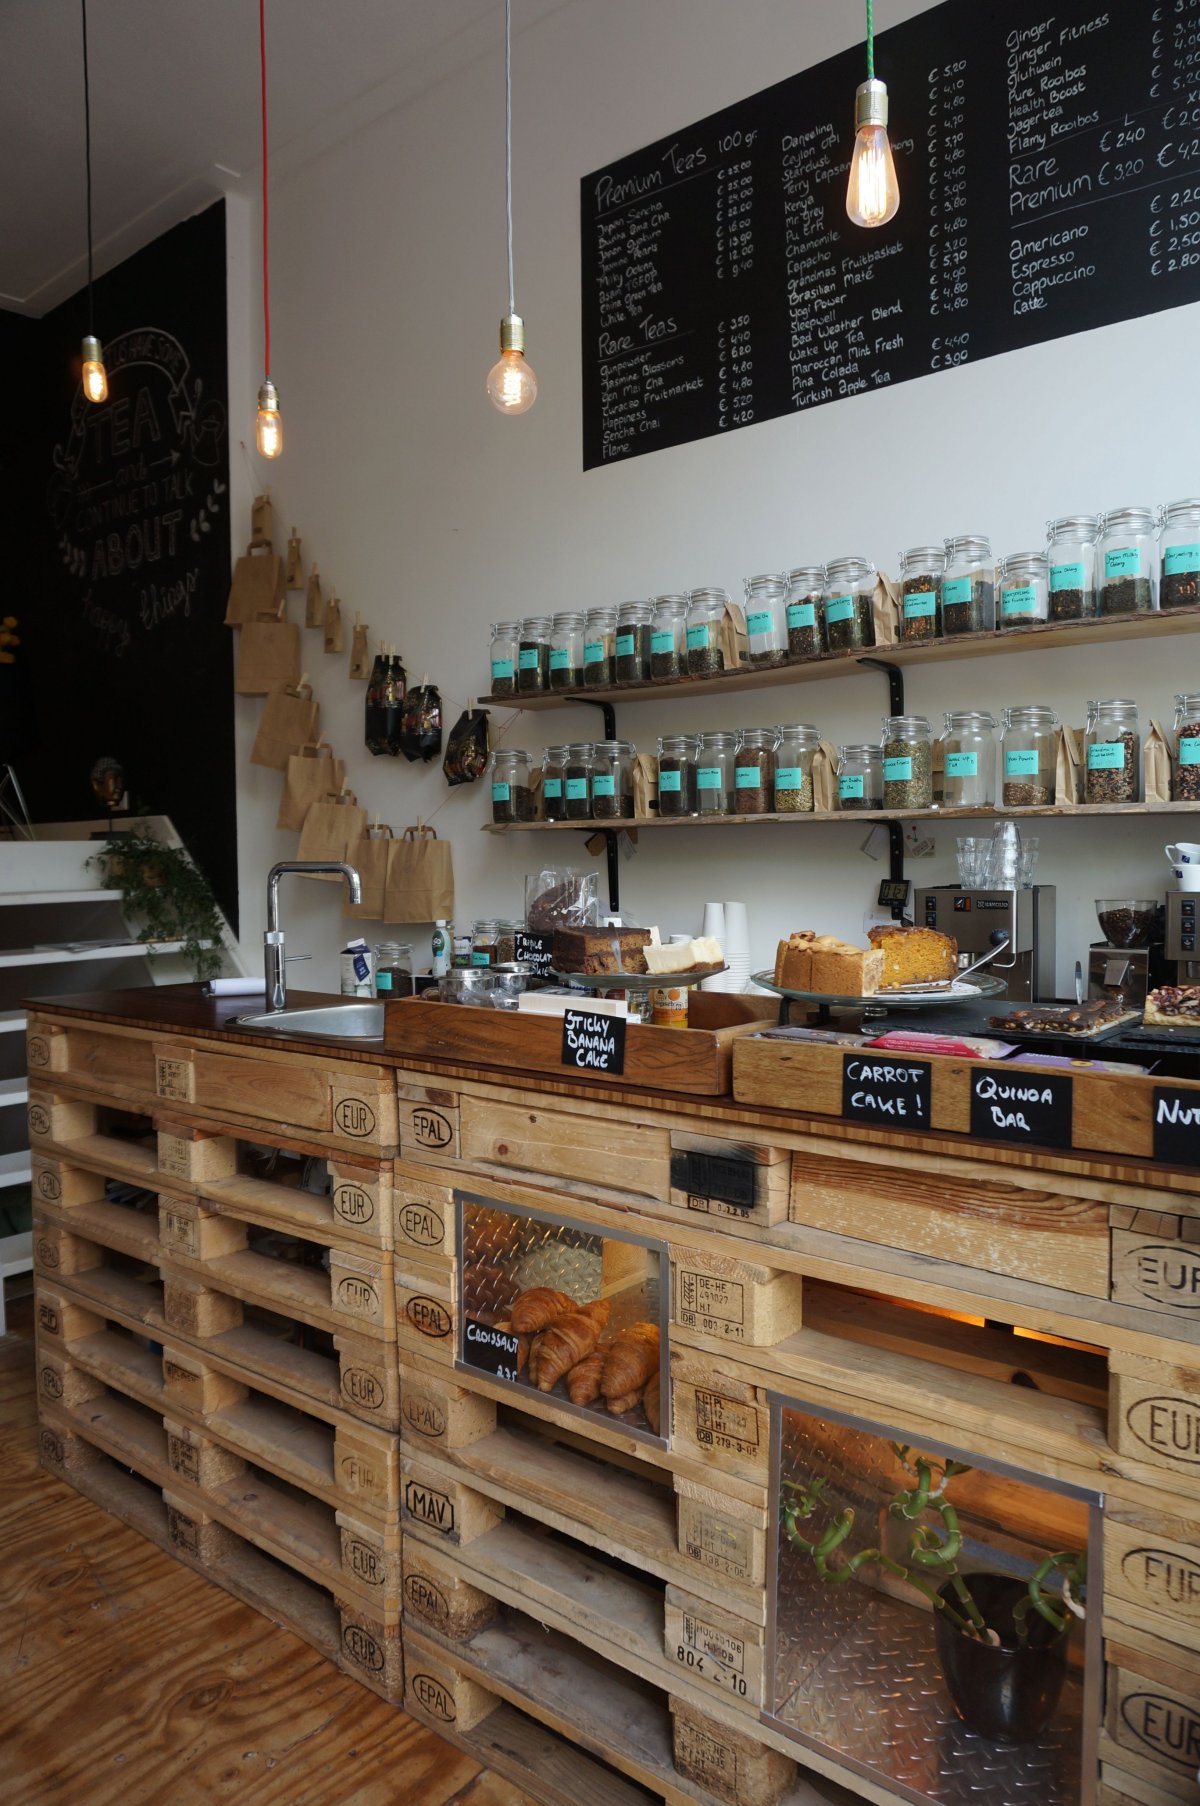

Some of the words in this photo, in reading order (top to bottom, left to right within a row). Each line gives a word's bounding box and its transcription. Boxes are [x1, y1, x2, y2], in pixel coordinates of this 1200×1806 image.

[1059, 13, 1110, 46] Fitness
[1008, 89, 1035, 104] Pure
[1040, 64, 1087, 92] Rooibos
[1009, 97, 1045, 118] Health
[1050, 80, 1086, 104] Boost
[1009, 133, 1047, 154] Flamy
[1050, 110, 1099, 137] Rooibos
[1100, 130, 1112, 152] €
[595, 171, 663, 212] Premium
[662, 144, 707, 176] Teas
[718, 131, 742, 153] 100
[782, 154, 831, 181] Stardust
[1009, 157, 1060, 189] Rare
[1009, 174, 1092, 216] Premium
[1098, 161, 1110, 186] €
[784, 195, 815, 214] Kenya
[1150, 195, 1163, 214] €
[1149, 219, 1163, 237] €
[785, 229, 841, 258] Chamomile
[841, 241, 904, 272] Fruitbasket
[1150, 240, 1162, 257] €
[1011, 250, 1075, 280] Espresso
[1150, 259, 1162, 276] €
[1012, 265, 1096, 297] Cappuccino
[1013, 296, 1048, 315] Latte
[599, 332, 636, 358] Rare
[639, 313, 678, 340] Teas
[790, 309, 837, 334] Sleepwell
[791, 331, 812, 348] Bad
[818, 315, 864, 339] Weather
[871, 299, 903, 321] Blend
[789, 345, 819, 362] Wake
[824, 340, 839, 353] Up
[845, 329, 865, 344] Tea
[875, 333, 904, 354] Fresh
[932, 337, 941, 350] €
[821, 362, 859, 381] Colada
[931, 355, 941, 369] €
[791, 387, 833, 407] Turkish
[870, 369, 891, 385] Tea
[86, 385, 162, 465] TEA
[91, 509, 183, 581] ABOUT
[565, 1011, 610, 1038] STICKY
[567, 1030, 615, 1055] BANANA
[576, 1048, 609, 1069] CAKE
[846, 1061, 925, 1084] CARROT
[975, 1076, 1053, 1105] QUINOA
[342, 1104, 368, 1137] EUR
[413, 1114, 445, 1142] EPAL
[989, 1106, 1032, 1132] BAR
[341, 1190, 365, 1219] EUR
[405, 1209, 438, 1240] EPAL
[346, 1283, 371, 1312] EUR
[699, 1278, 727, 1294] DE-HE
[413, 1302, 446, 1333] EPAL
[699, 1302, 711, 1313] HT
[467, 1324, 519, 1354] CROISSANT
[350, 1373, 376, 1404] EUR
[714, 1398, 725, 1410] PL
[700, 1431, 711, 1442] DB
[715, 1420, 727, 1432] HT
[353, 1546, 378, 1580] EUR
[351, 1630, 376, 1667] EUR
[419, 1679, 452, 1718] EPAL
